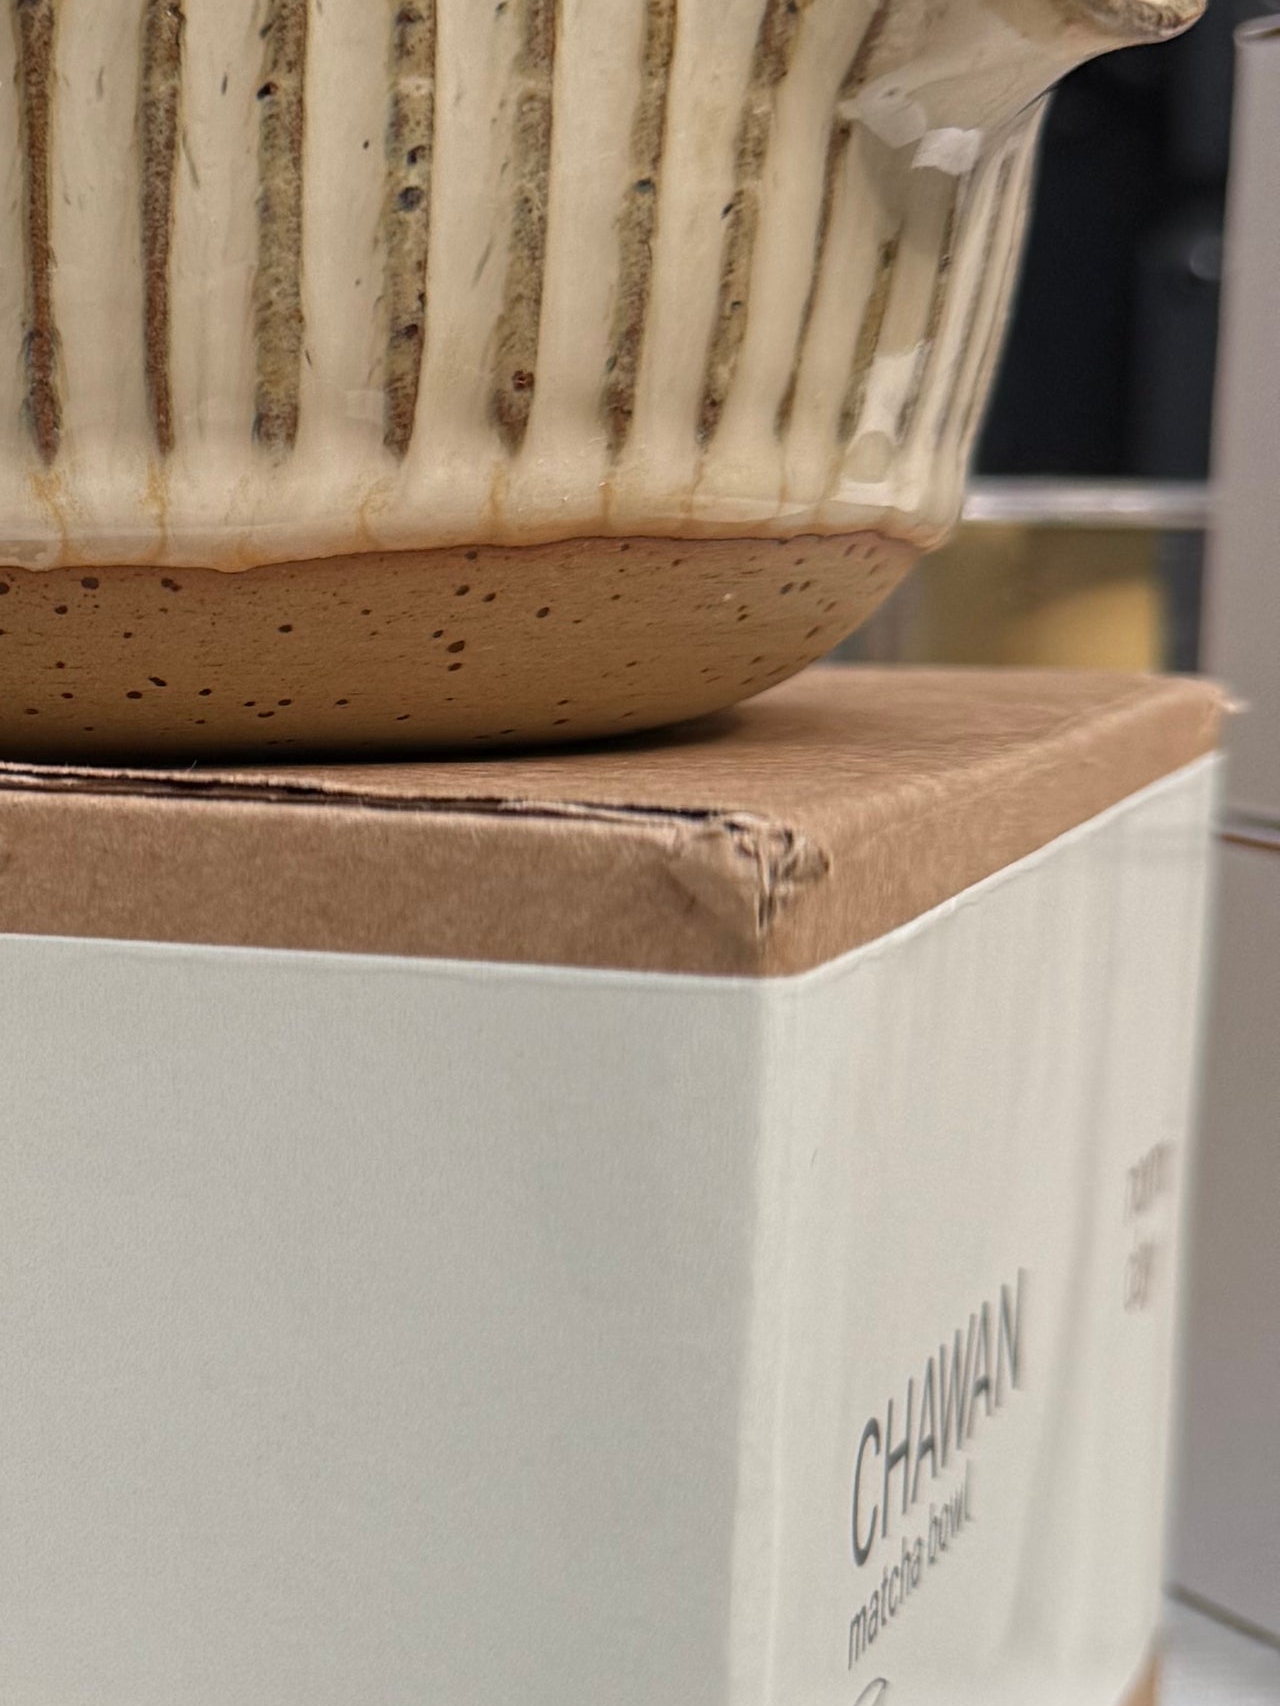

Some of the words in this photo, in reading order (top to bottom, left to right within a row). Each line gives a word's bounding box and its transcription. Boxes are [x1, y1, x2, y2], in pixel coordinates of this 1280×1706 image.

[851, 1267, 1026, 1567] CHAWAN
[848, 1535, 924, 1671] matcha
[927, 1458, 973, 1566] bowl
